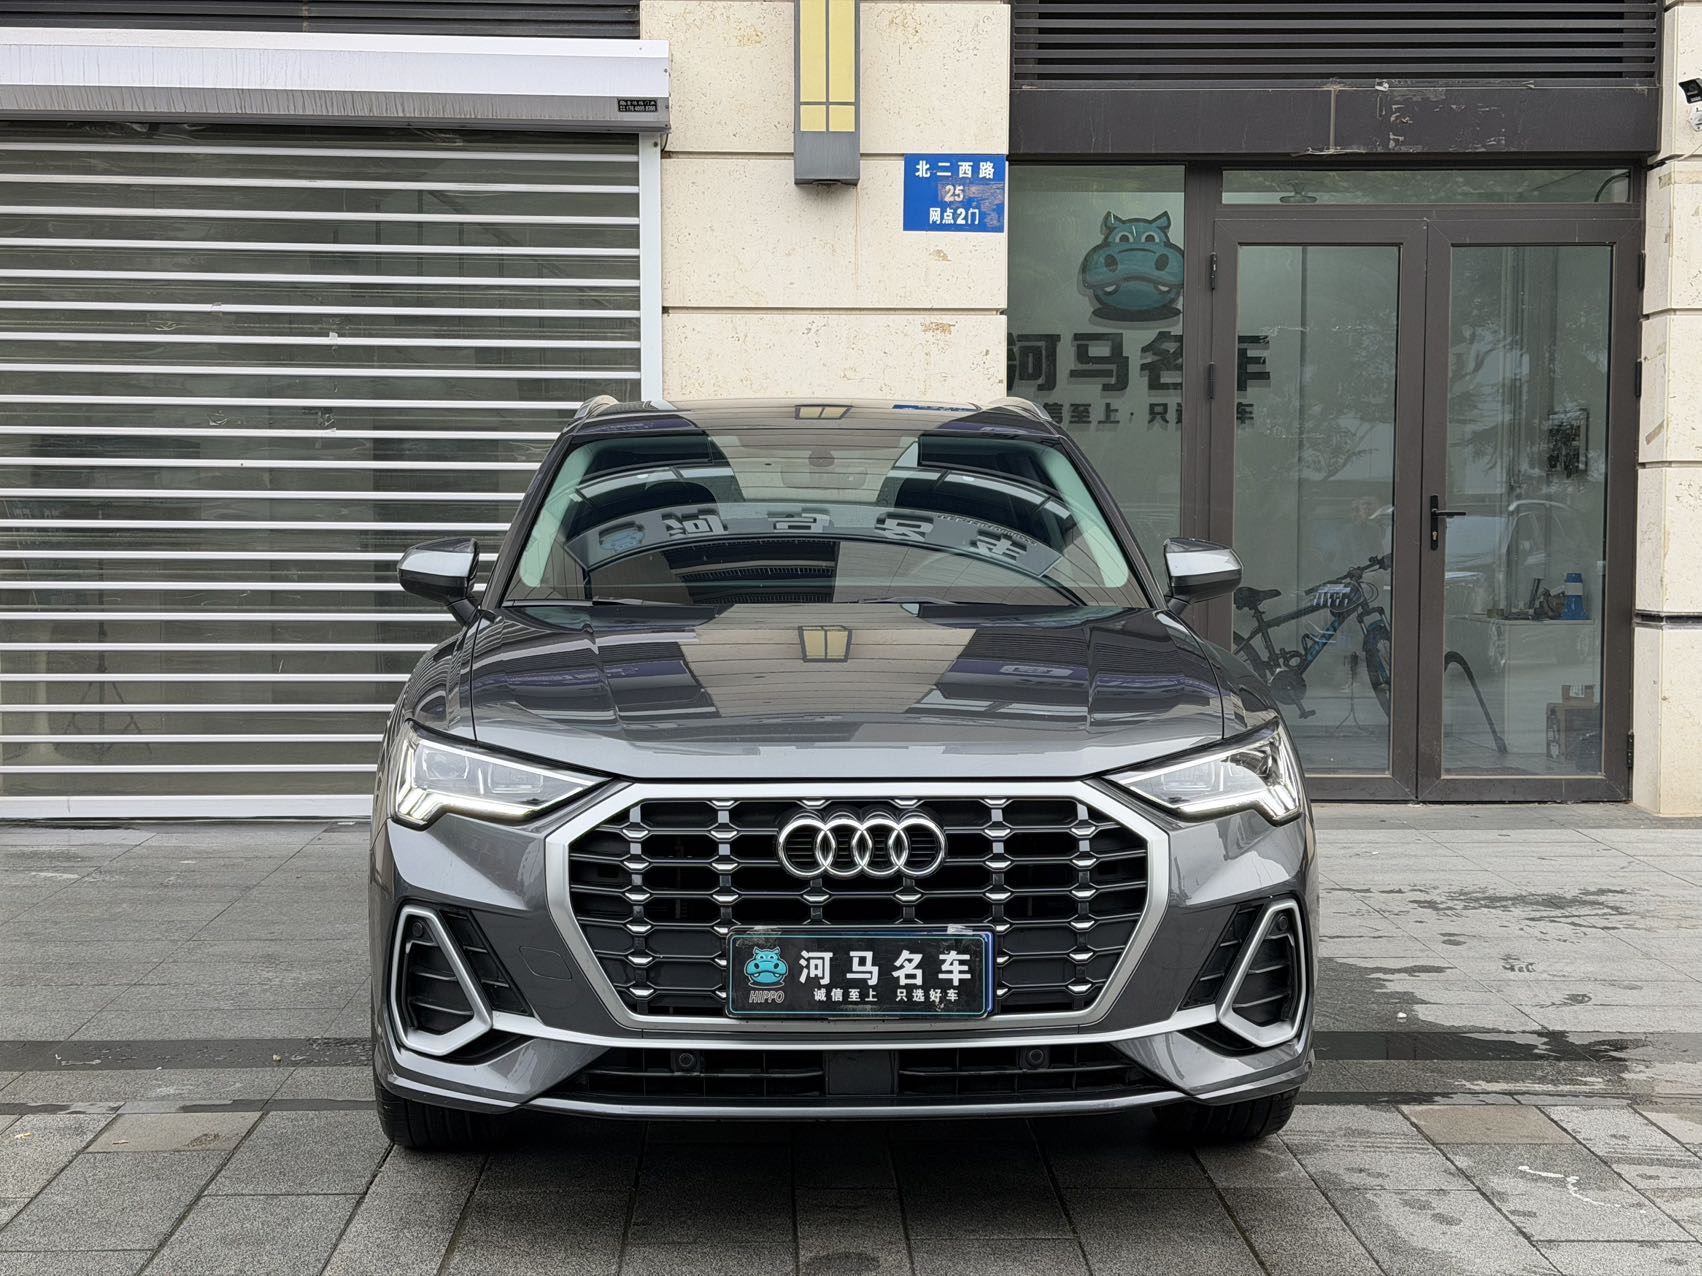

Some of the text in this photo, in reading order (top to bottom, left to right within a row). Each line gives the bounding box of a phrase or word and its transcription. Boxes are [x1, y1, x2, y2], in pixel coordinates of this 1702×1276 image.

[915, 160, 995, 178] 北二西路
[944, 185, 964, 202] 25
[929, 207, 979, 224] 网点2门
[799, 949, 971, 986] 河马名车
[749, 990, 785, 1004] HIPPO
[813, 988, 959, 1003] 诚信至上 只选好车
